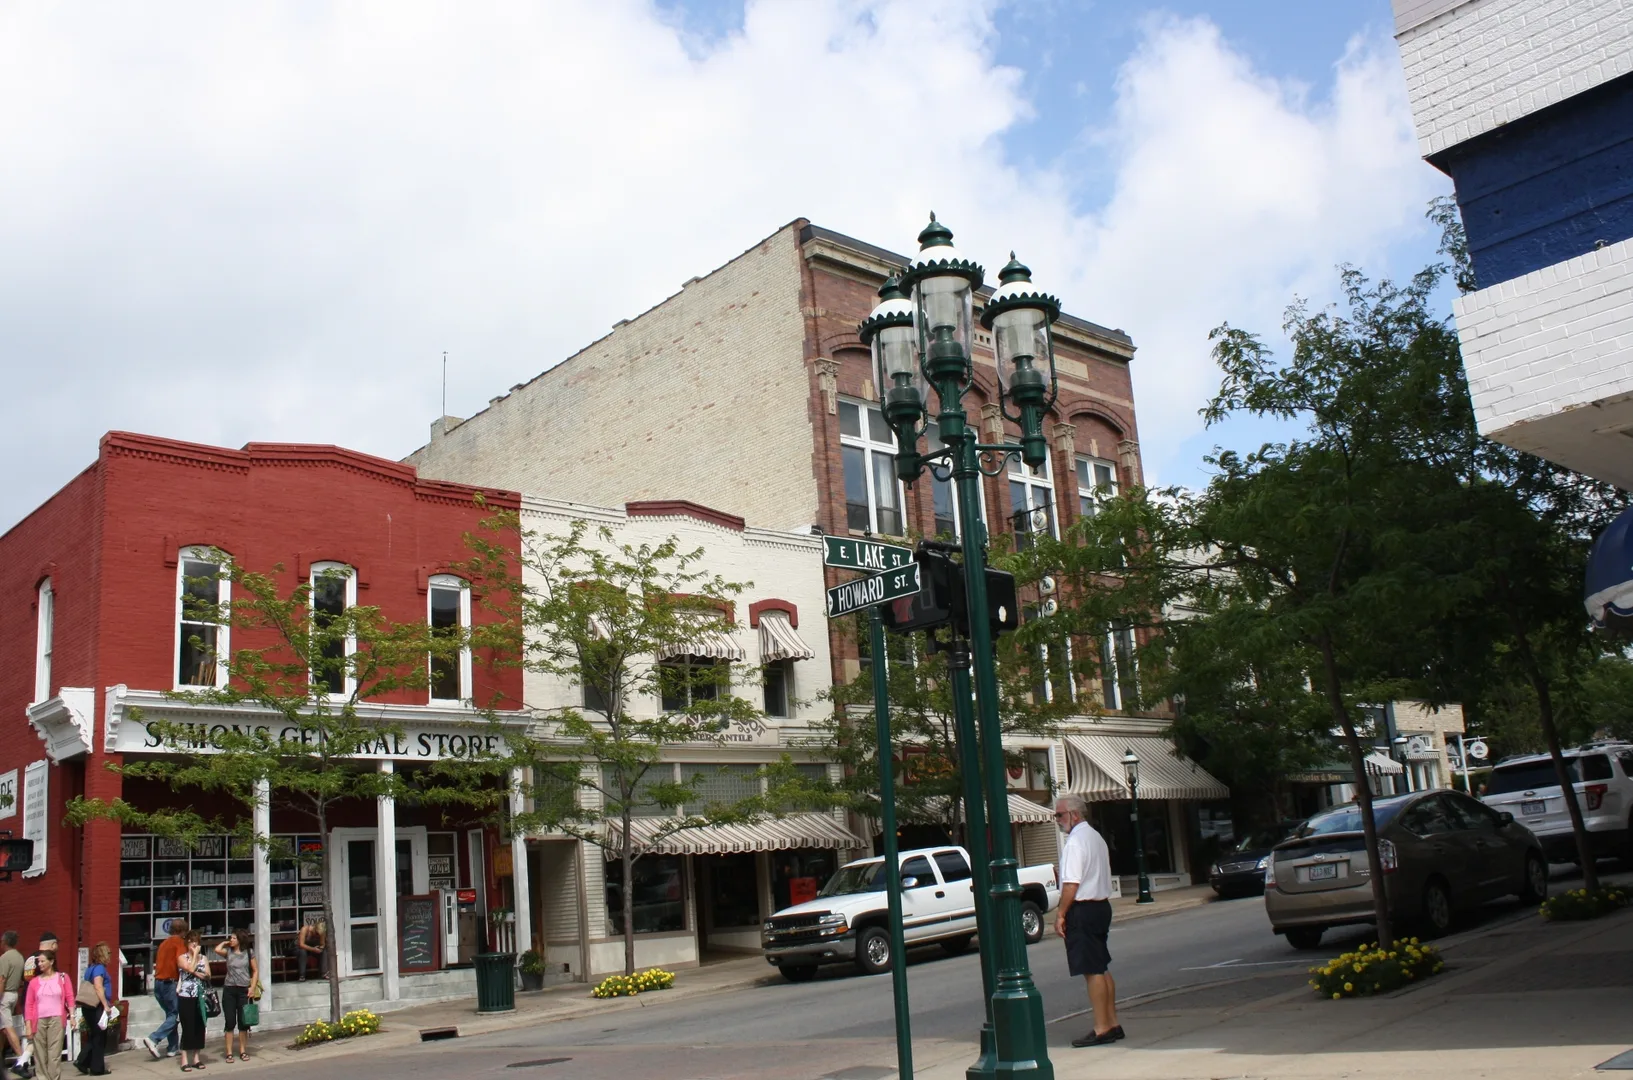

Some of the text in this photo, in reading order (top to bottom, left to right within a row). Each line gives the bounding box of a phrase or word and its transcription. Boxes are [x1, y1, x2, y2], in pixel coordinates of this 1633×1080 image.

[840, 546, 849, 559] E.
[855, 542, 887, 569] LAKE
[837, 574, 909, 612] HOWARD ST.
[279, 726, 410, 755] GENRAL
[417, 732, 500, 758] STORE
[693, 733, 753, 743] MERCANTILE
[124, 840, 145, 848] WINE
[163, 838, 181, 848] COLD
[197, 838, 221, 856] JAM
